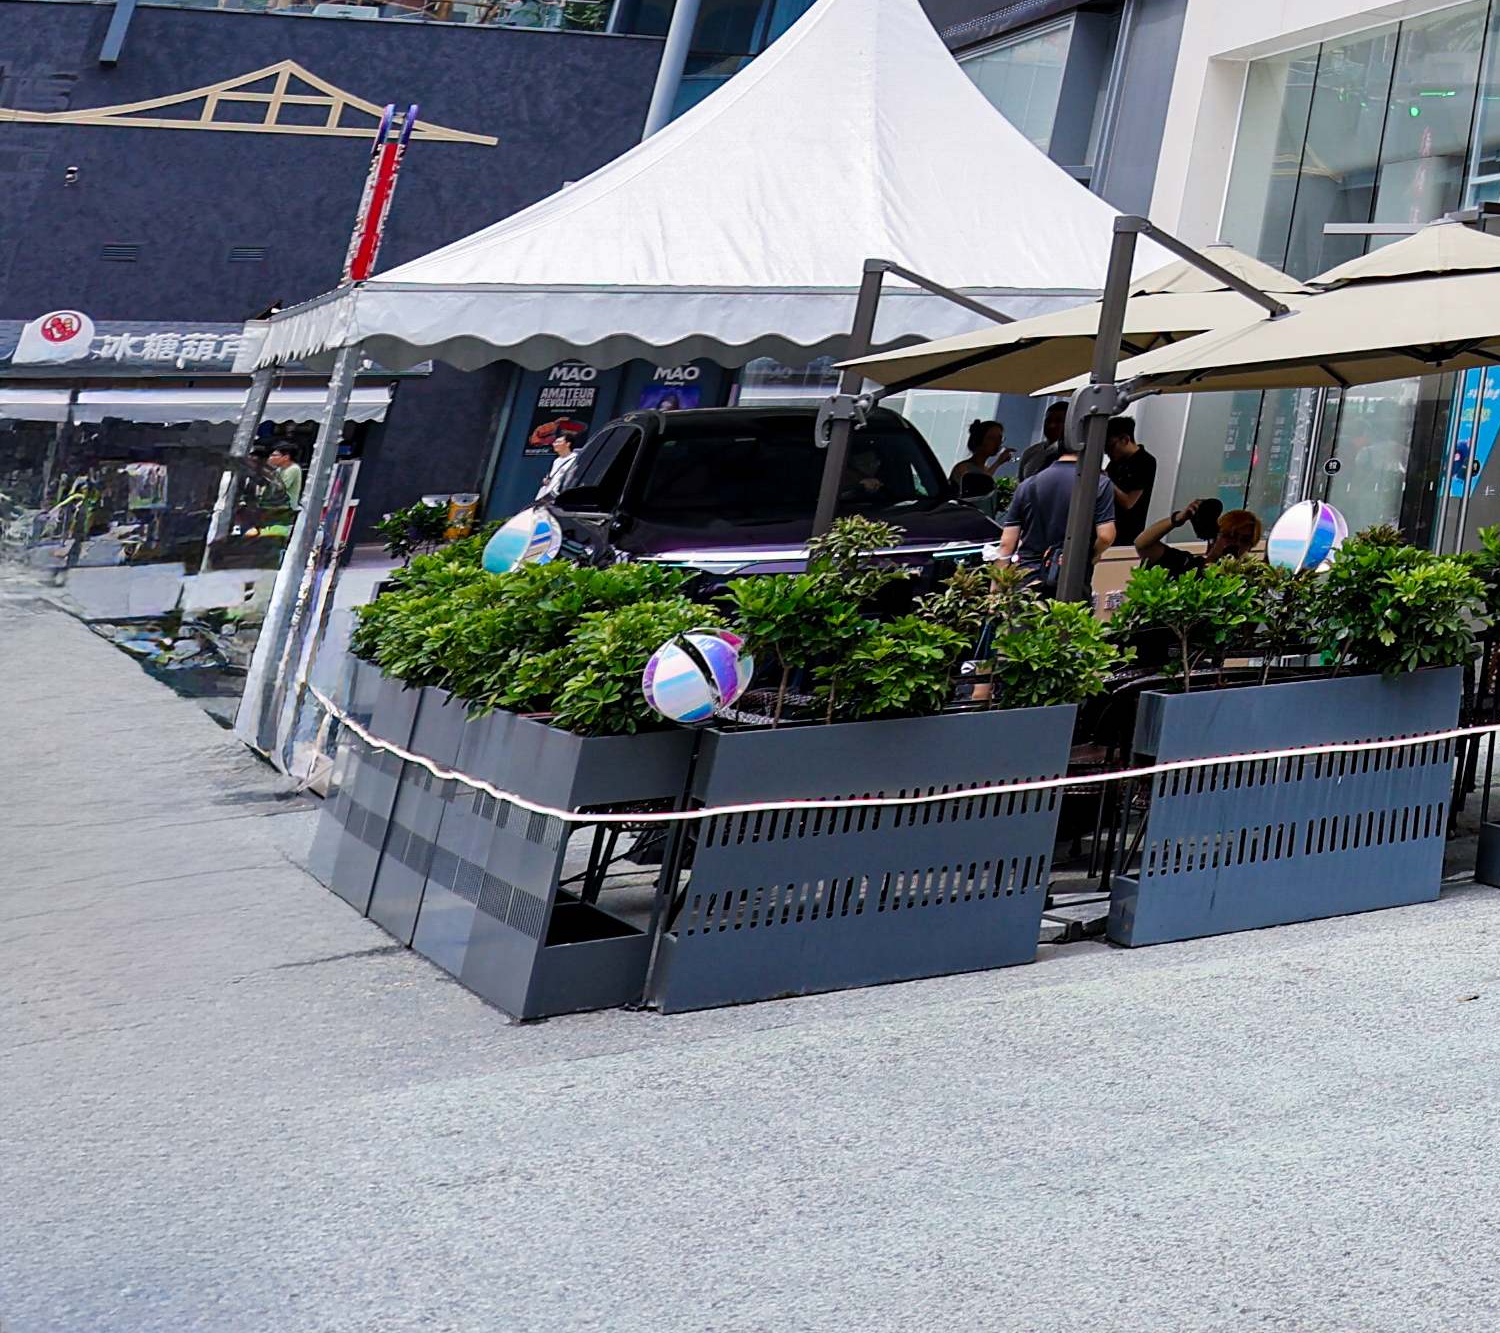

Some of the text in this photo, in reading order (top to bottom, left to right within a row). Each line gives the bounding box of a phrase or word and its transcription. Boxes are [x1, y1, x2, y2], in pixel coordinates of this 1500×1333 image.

[549, 367, 597, 381] MAO
[653, 367, 699, 381] MAO
[540, 388, 596, 399] AMATEUR
[538, 399, 593, 408] REVOLUTION
